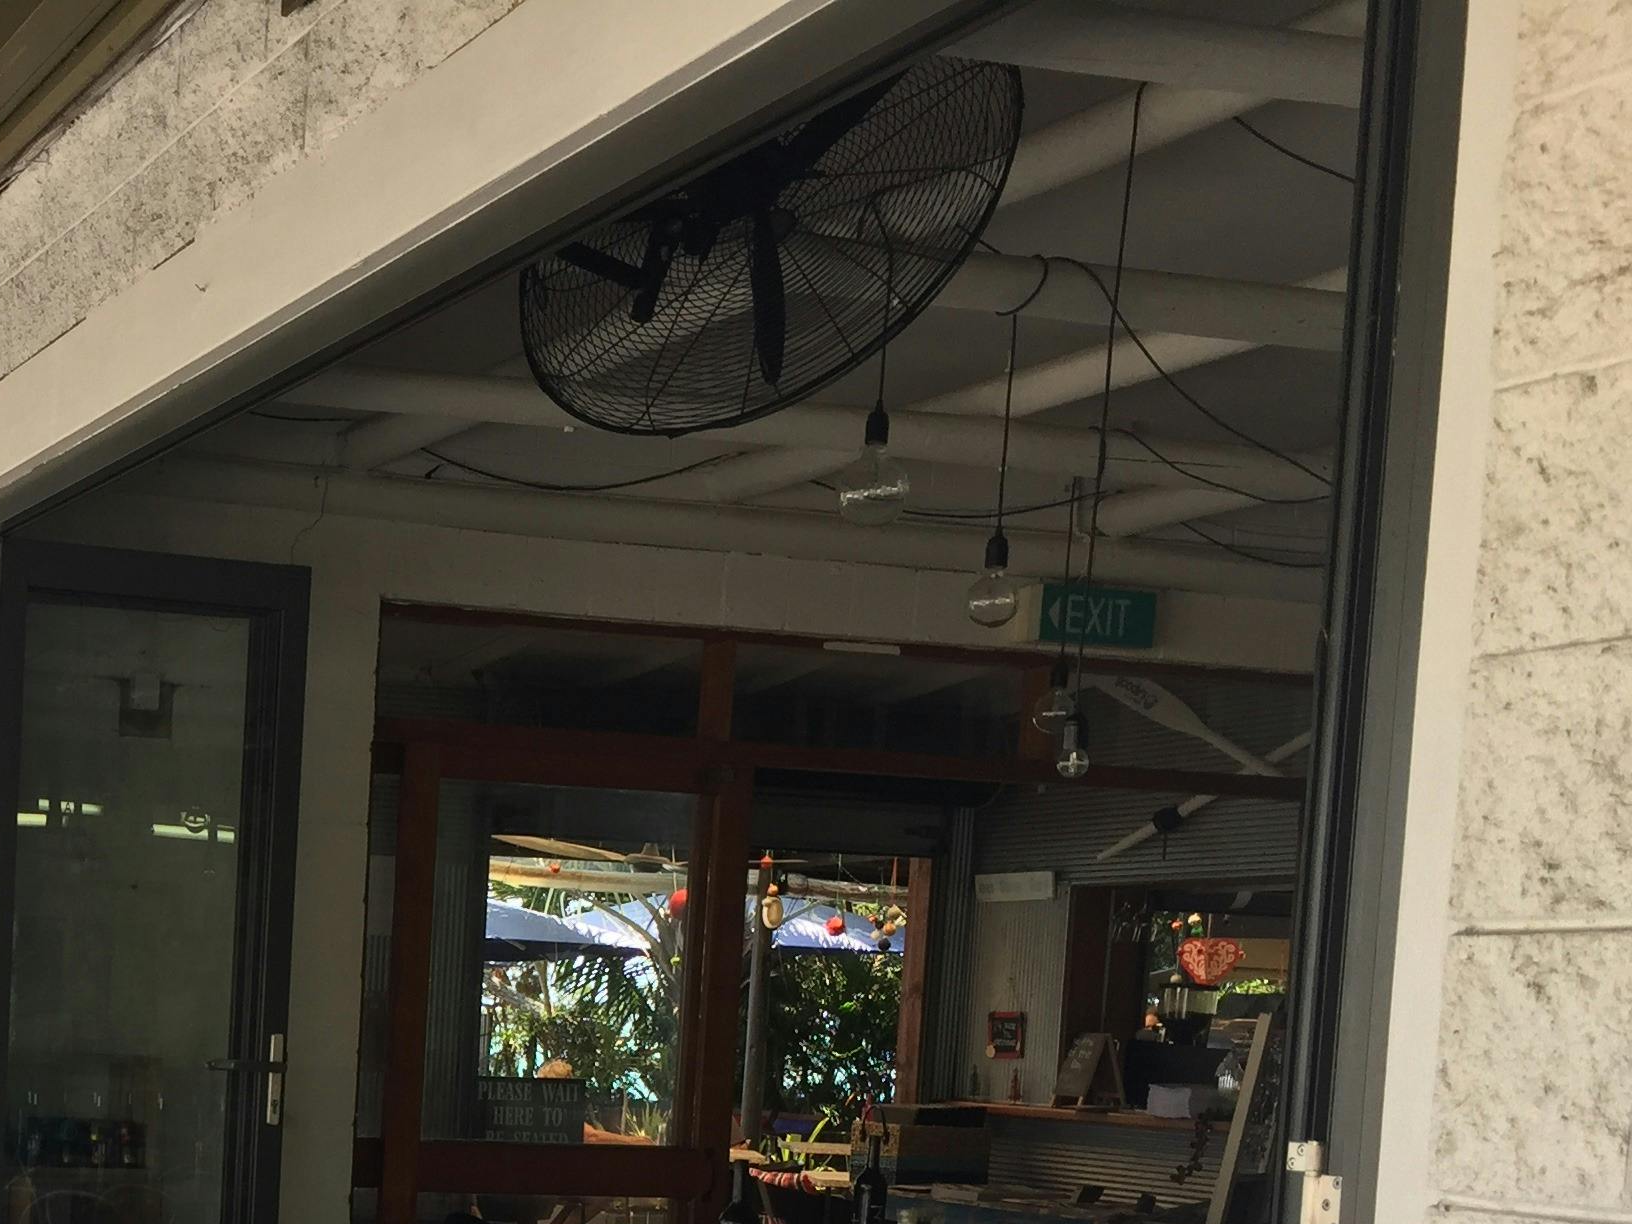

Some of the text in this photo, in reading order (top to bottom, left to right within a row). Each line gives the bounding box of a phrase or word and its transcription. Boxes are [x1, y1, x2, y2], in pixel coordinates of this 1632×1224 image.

[1066, 593, 1132, 637] EXIT
[478, 1081, 580, 1103] PLEASE WAIT
[494, 1106, 563, 1127] HERE TO
